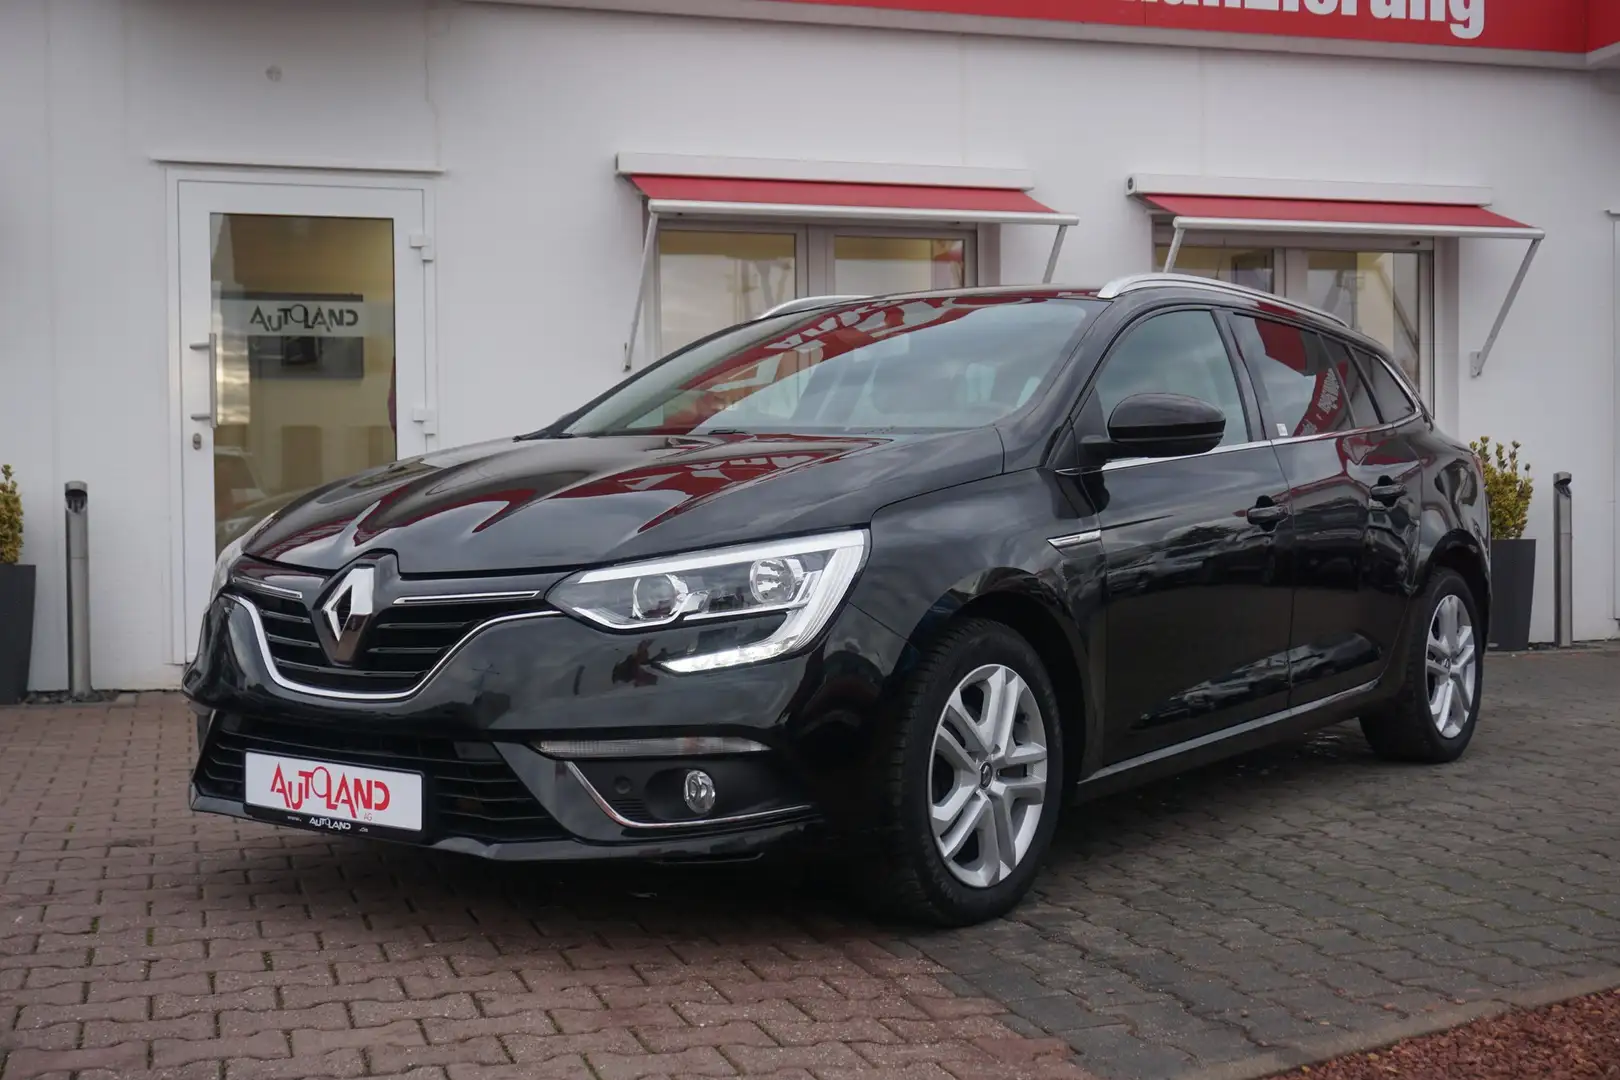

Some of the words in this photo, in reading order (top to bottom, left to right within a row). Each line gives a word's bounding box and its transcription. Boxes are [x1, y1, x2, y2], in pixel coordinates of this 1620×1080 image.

[250, 304, 358, 332] AUTOLAND
[270, 762, 390, 819] AUTOLAND
[363, 812, 373, 822] AG
